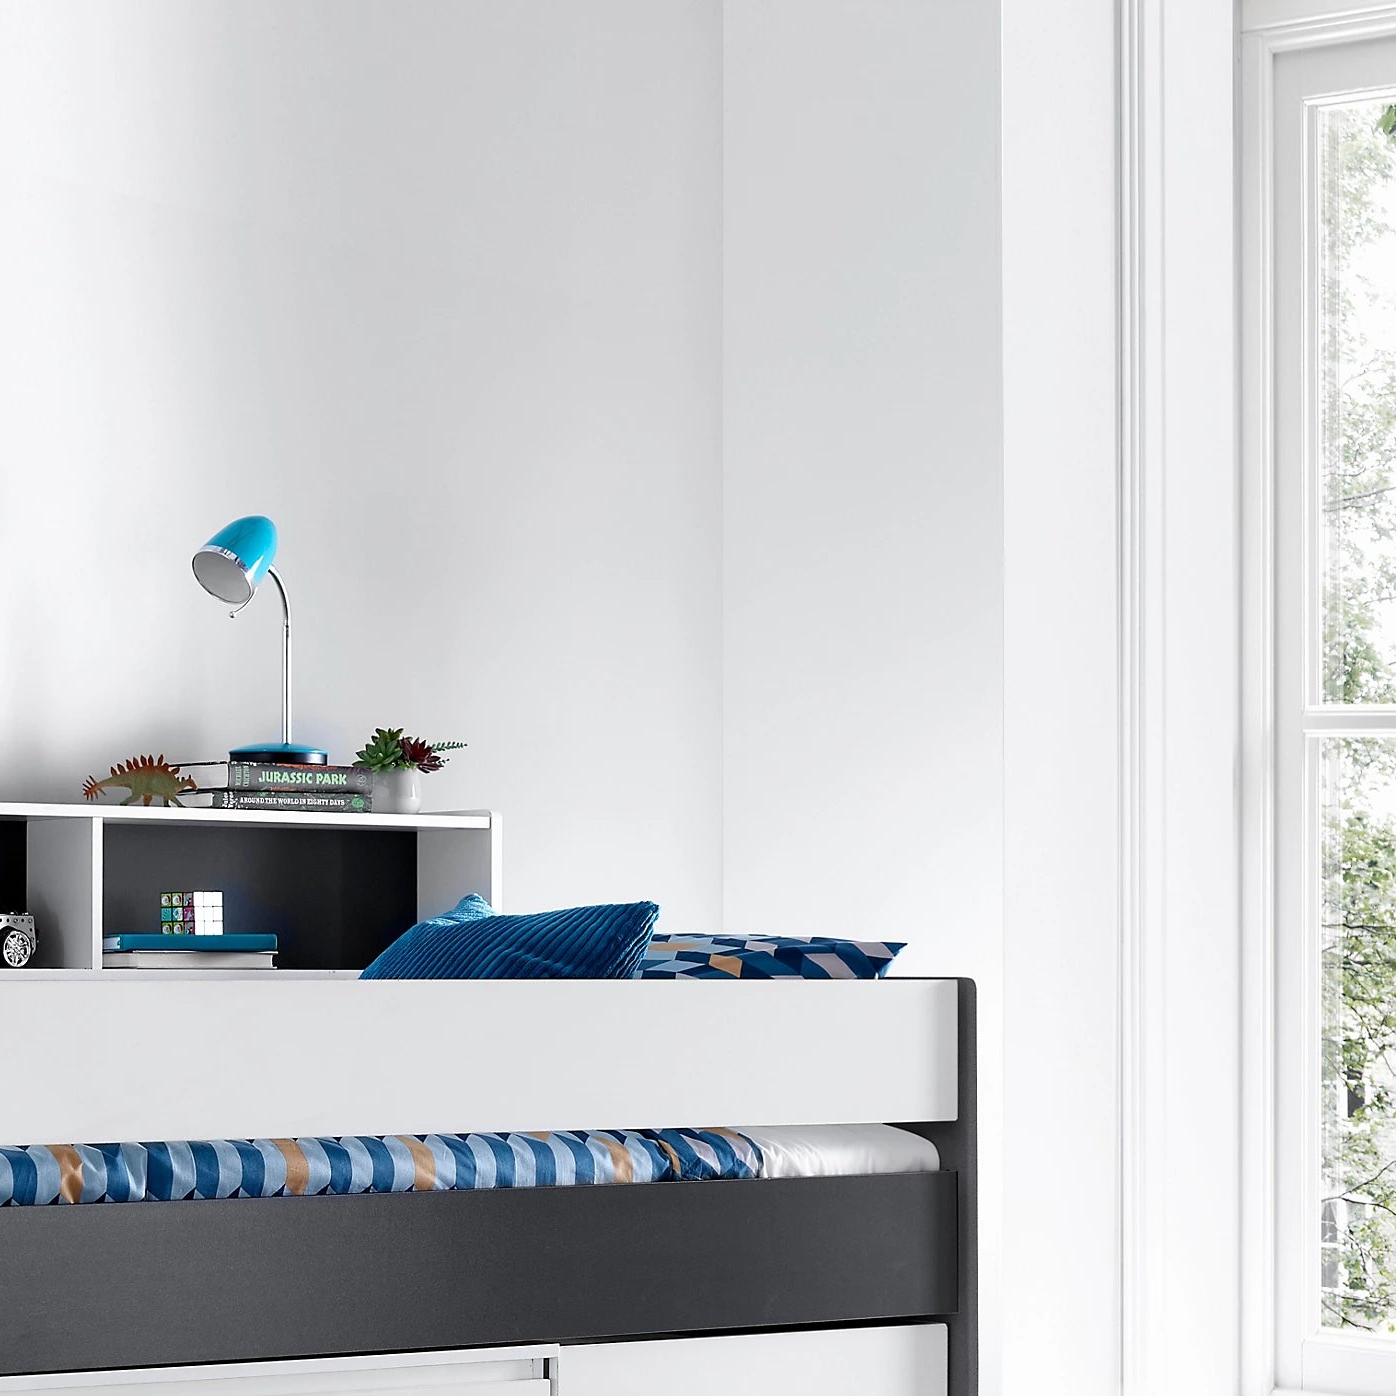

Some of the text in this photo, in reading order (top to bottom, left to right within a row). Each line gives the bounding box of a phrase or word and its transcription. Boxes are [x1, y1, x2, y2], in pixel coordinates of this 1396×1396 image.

[259, 770, 347, 785] JURASSIC PARK
[264, 797, 278, 805] THE
